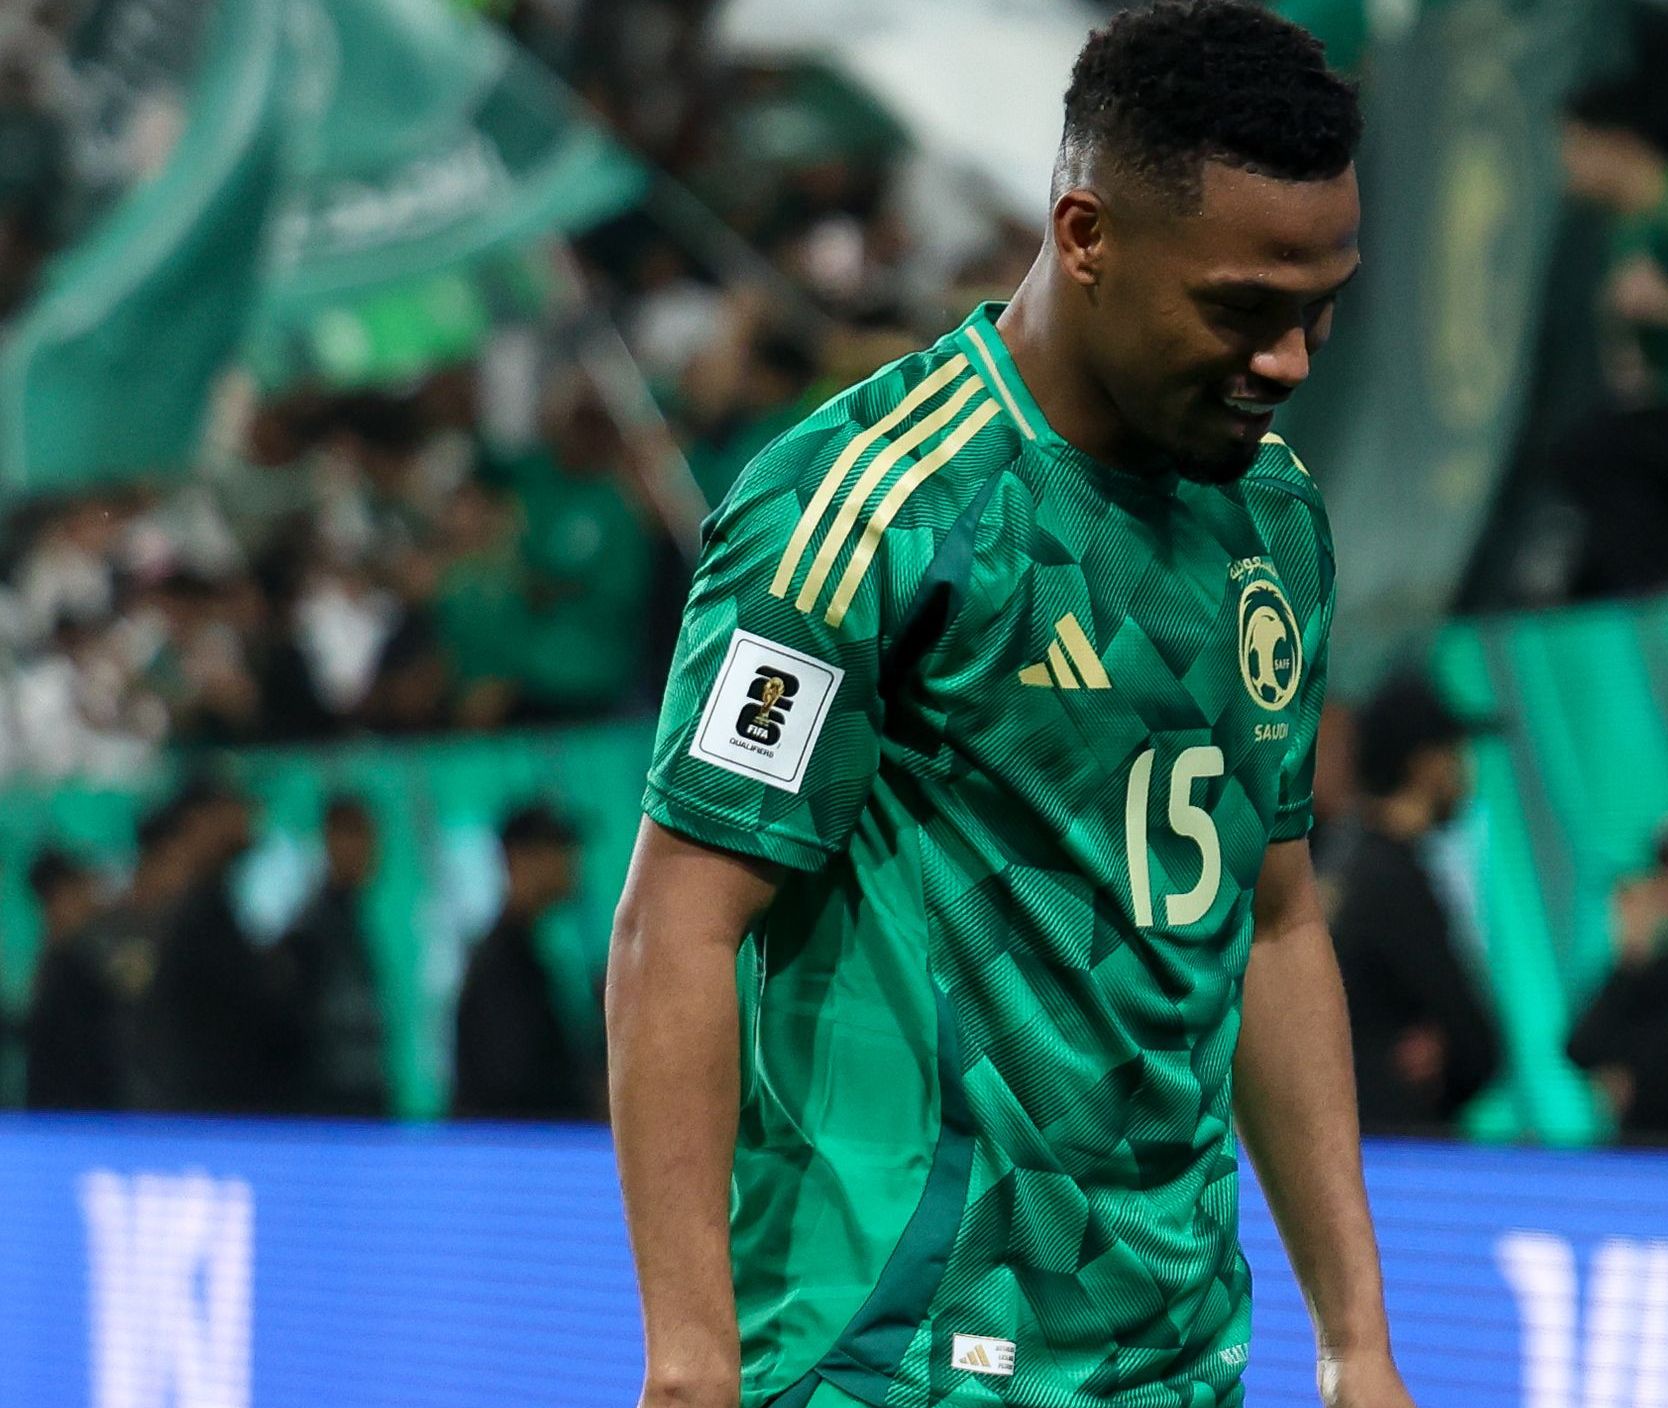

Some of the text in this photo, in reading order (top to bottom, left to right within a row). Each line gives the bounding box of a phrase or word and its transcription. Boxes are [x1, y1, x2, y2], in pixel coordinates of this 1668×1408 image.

[1274, 658, 1291, 671] SAFF
[747, 724, 770, 740] FIFA
[1254, 723, 1289, 742] SAUDI
[729, 736, 775, 759] QUALIFIERS
[1125, 746, 1225, 927] 15
